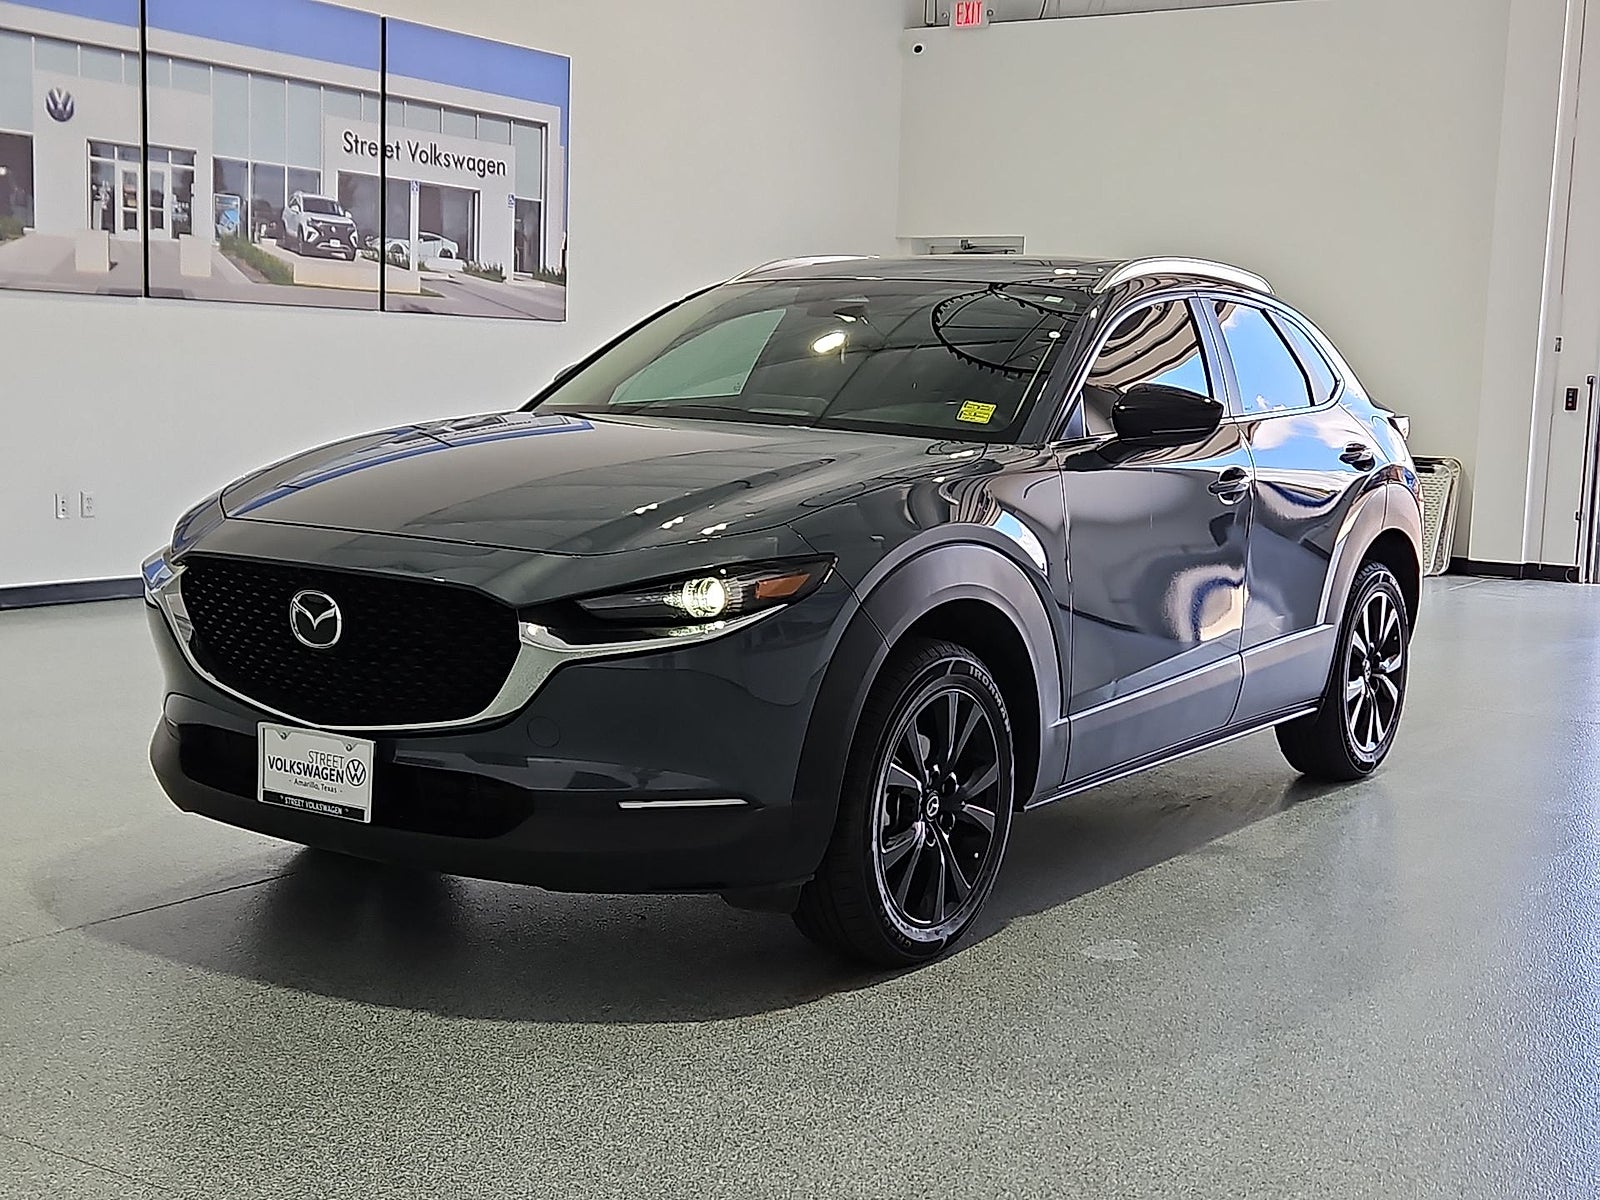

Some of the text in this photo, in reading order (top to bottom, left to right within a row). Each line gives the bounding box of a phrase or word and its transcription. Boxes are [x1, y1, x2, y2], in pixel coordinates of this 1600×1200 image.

[956, 1, 982, 25] EXIT
[342, 130, 507, 177] Street Volkswagen
[969, 665, 1011, 733] IRONMAN
[267, 755, 345, 784] VOLKSWAGEN
[308, 750, 345, 769] STREET
[293, 778, 337, 794] Amarillo, Texas
[285, 796, 342, 815] STREET VOLKSWAGEN
